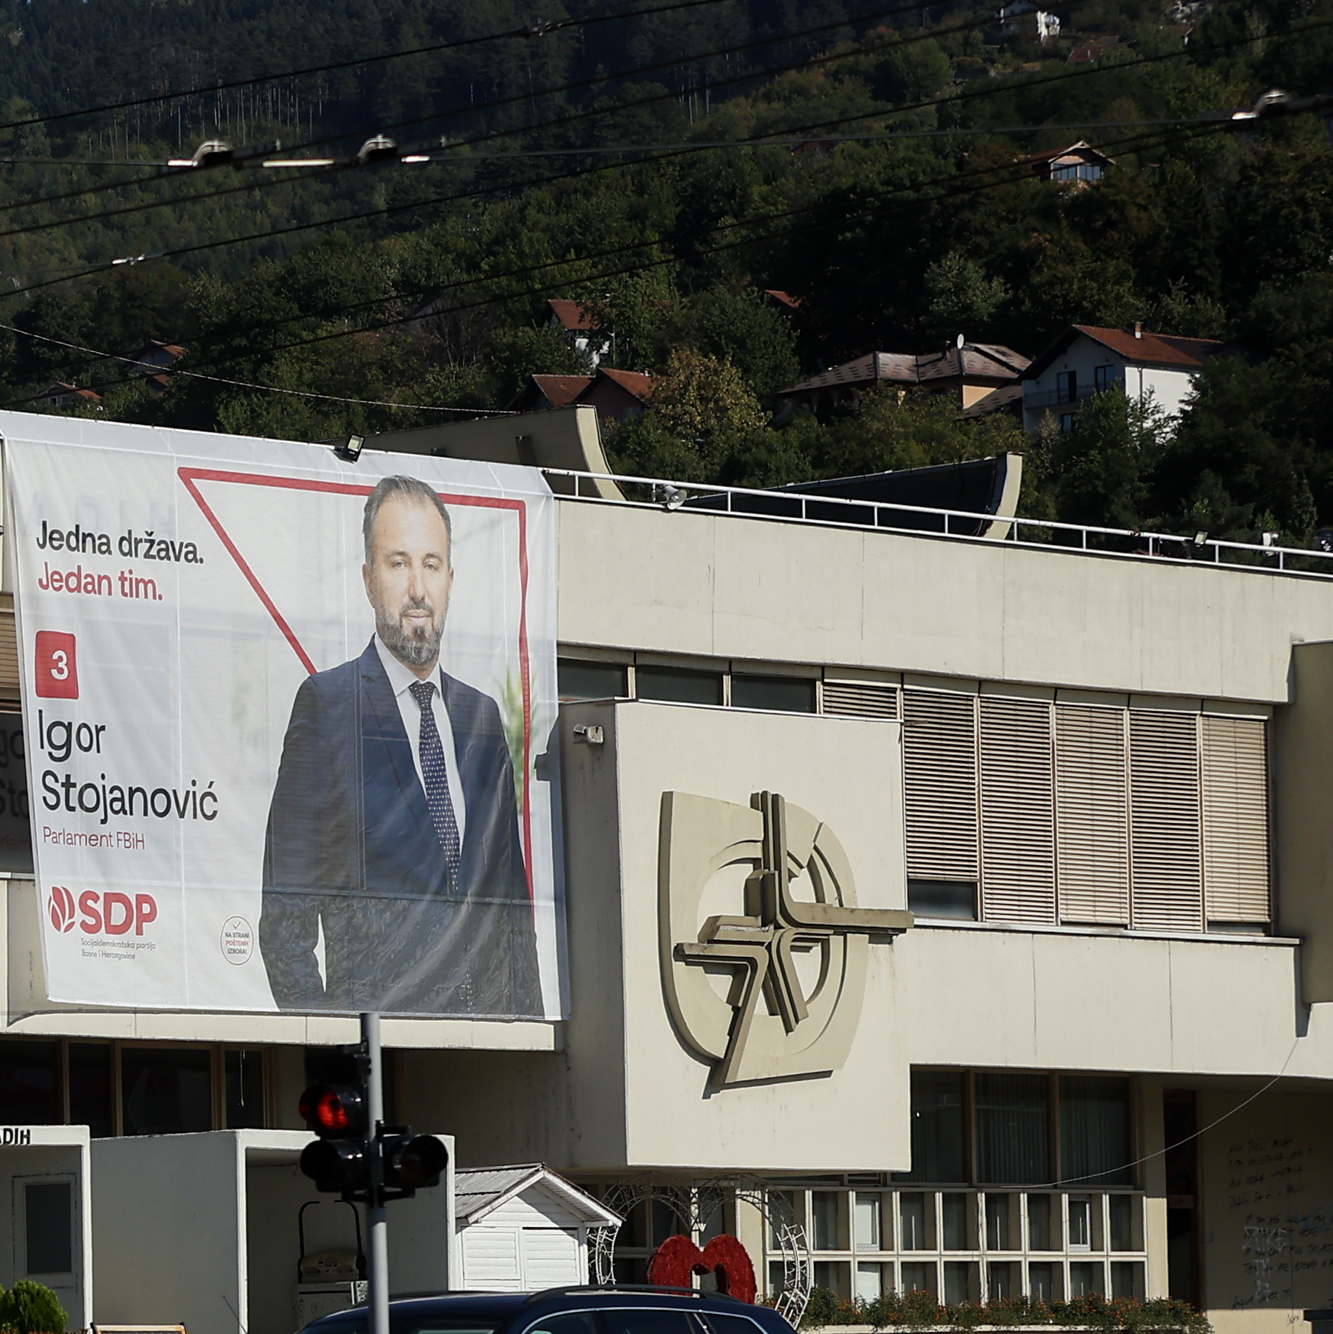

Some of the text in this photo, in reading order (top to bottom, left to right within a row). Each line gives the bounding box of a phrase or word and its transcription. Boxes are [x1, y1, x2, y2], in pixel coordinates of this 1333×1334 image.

[36, 520, 204, 565] Jedna država.
[38, 561, 163, 601] Jedan tim.
[50, 650, 69, 680] 3
[38, 709, 106, 763] Igor
[41, 770, 219, 824] Stojanović
[43, 826, 114, 848] Parlament
[117, 831, 145, 850] FBiH
[78, 890, 157, 936] SDP
[81, 937, 157, 951] Socijaldemokratska partija
